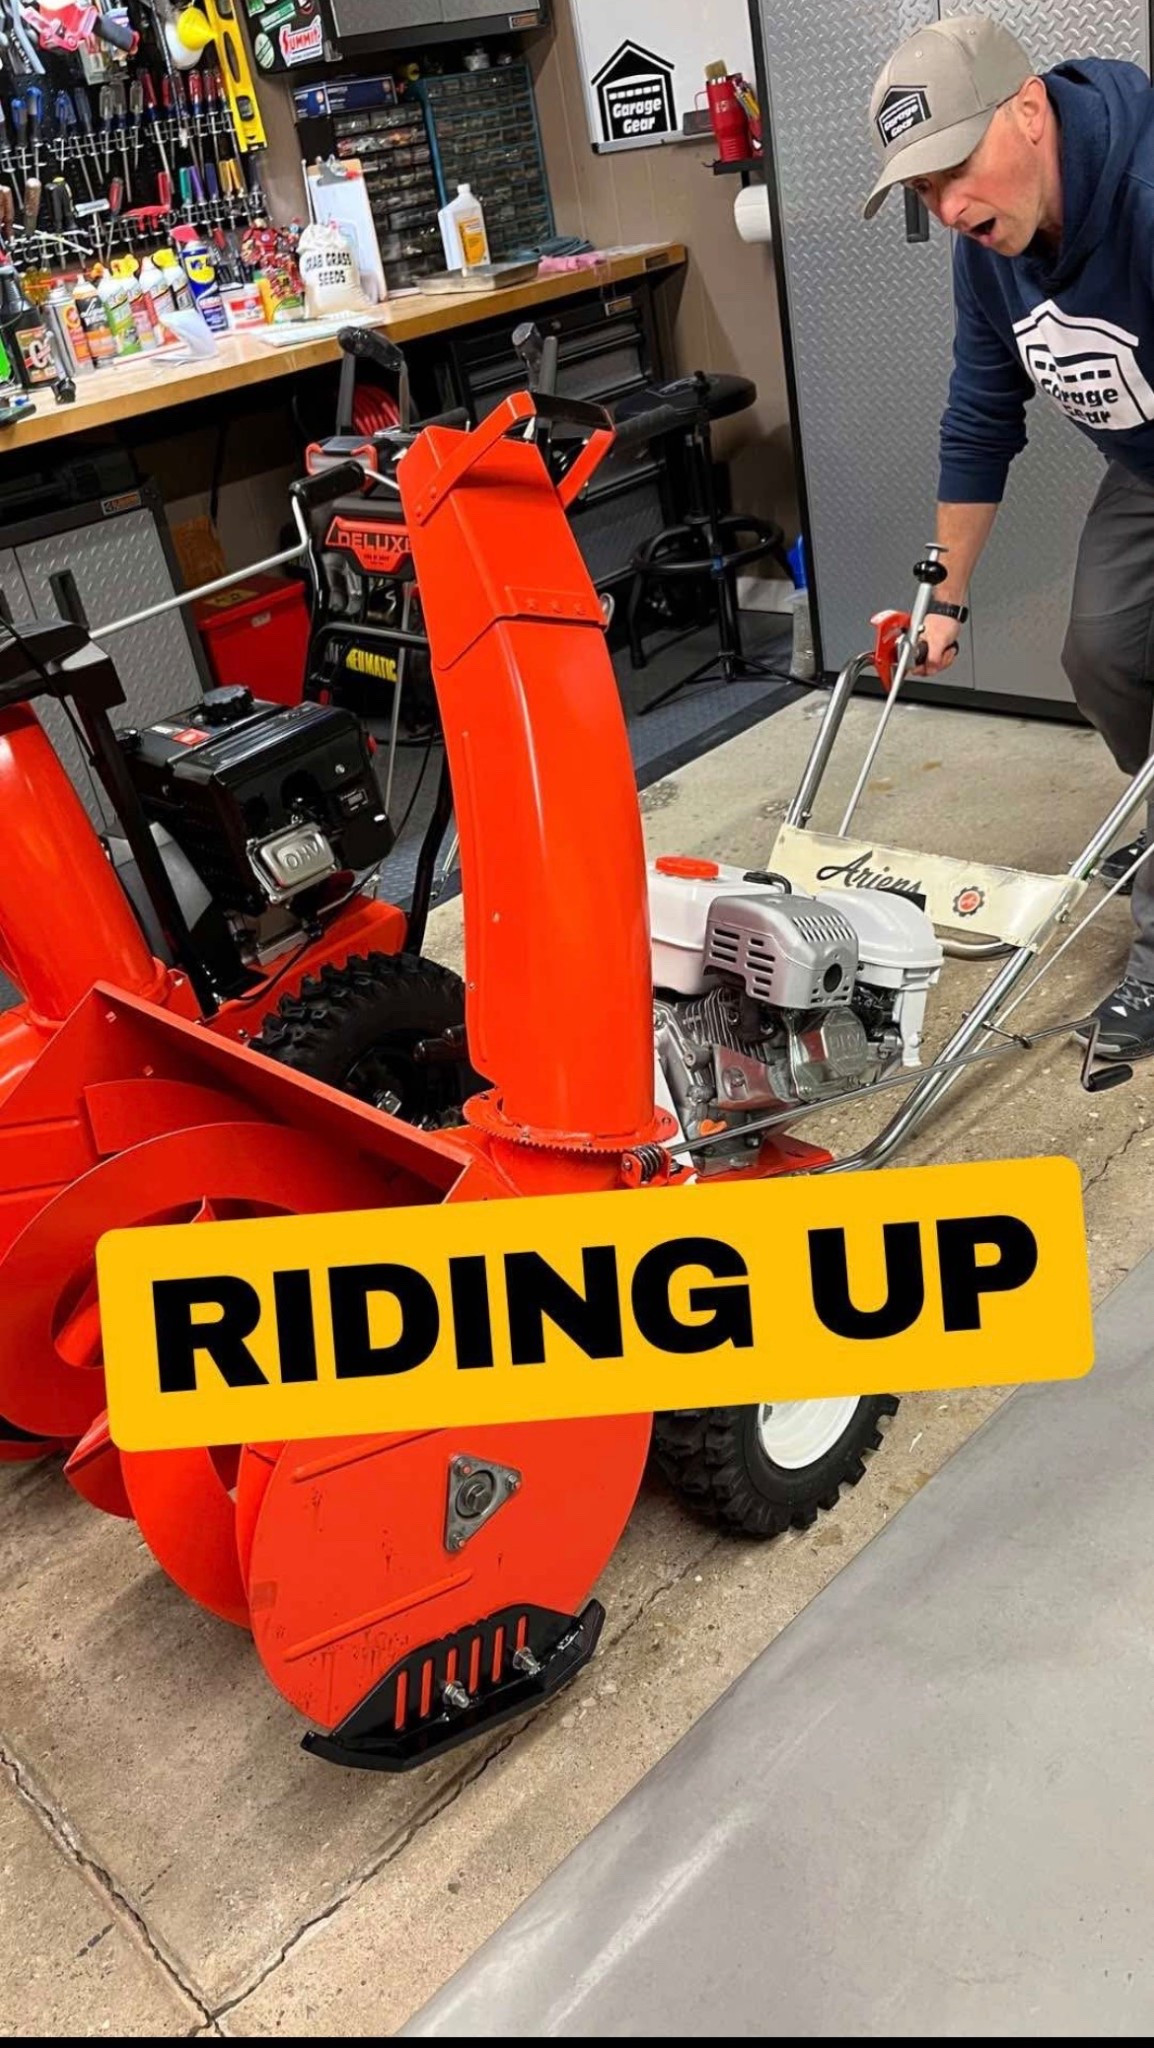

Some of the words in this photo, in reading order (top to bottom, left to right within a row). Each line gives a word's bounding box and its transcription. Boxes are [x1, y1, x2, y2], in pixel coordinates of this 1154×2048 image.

[612, 98, 662, 118] Garage
[623, 117, 656, 134] Gear
[326, 252, 352, 267] GRASS
[319, 270, 346, 287] SEEDS
[1041, 378, 1119, 408] Garage
[346, 648, 398, 682] NEUMATIC
[284, 840, 319, 870] OHV
[816, 850, 923, 893] Ariens
